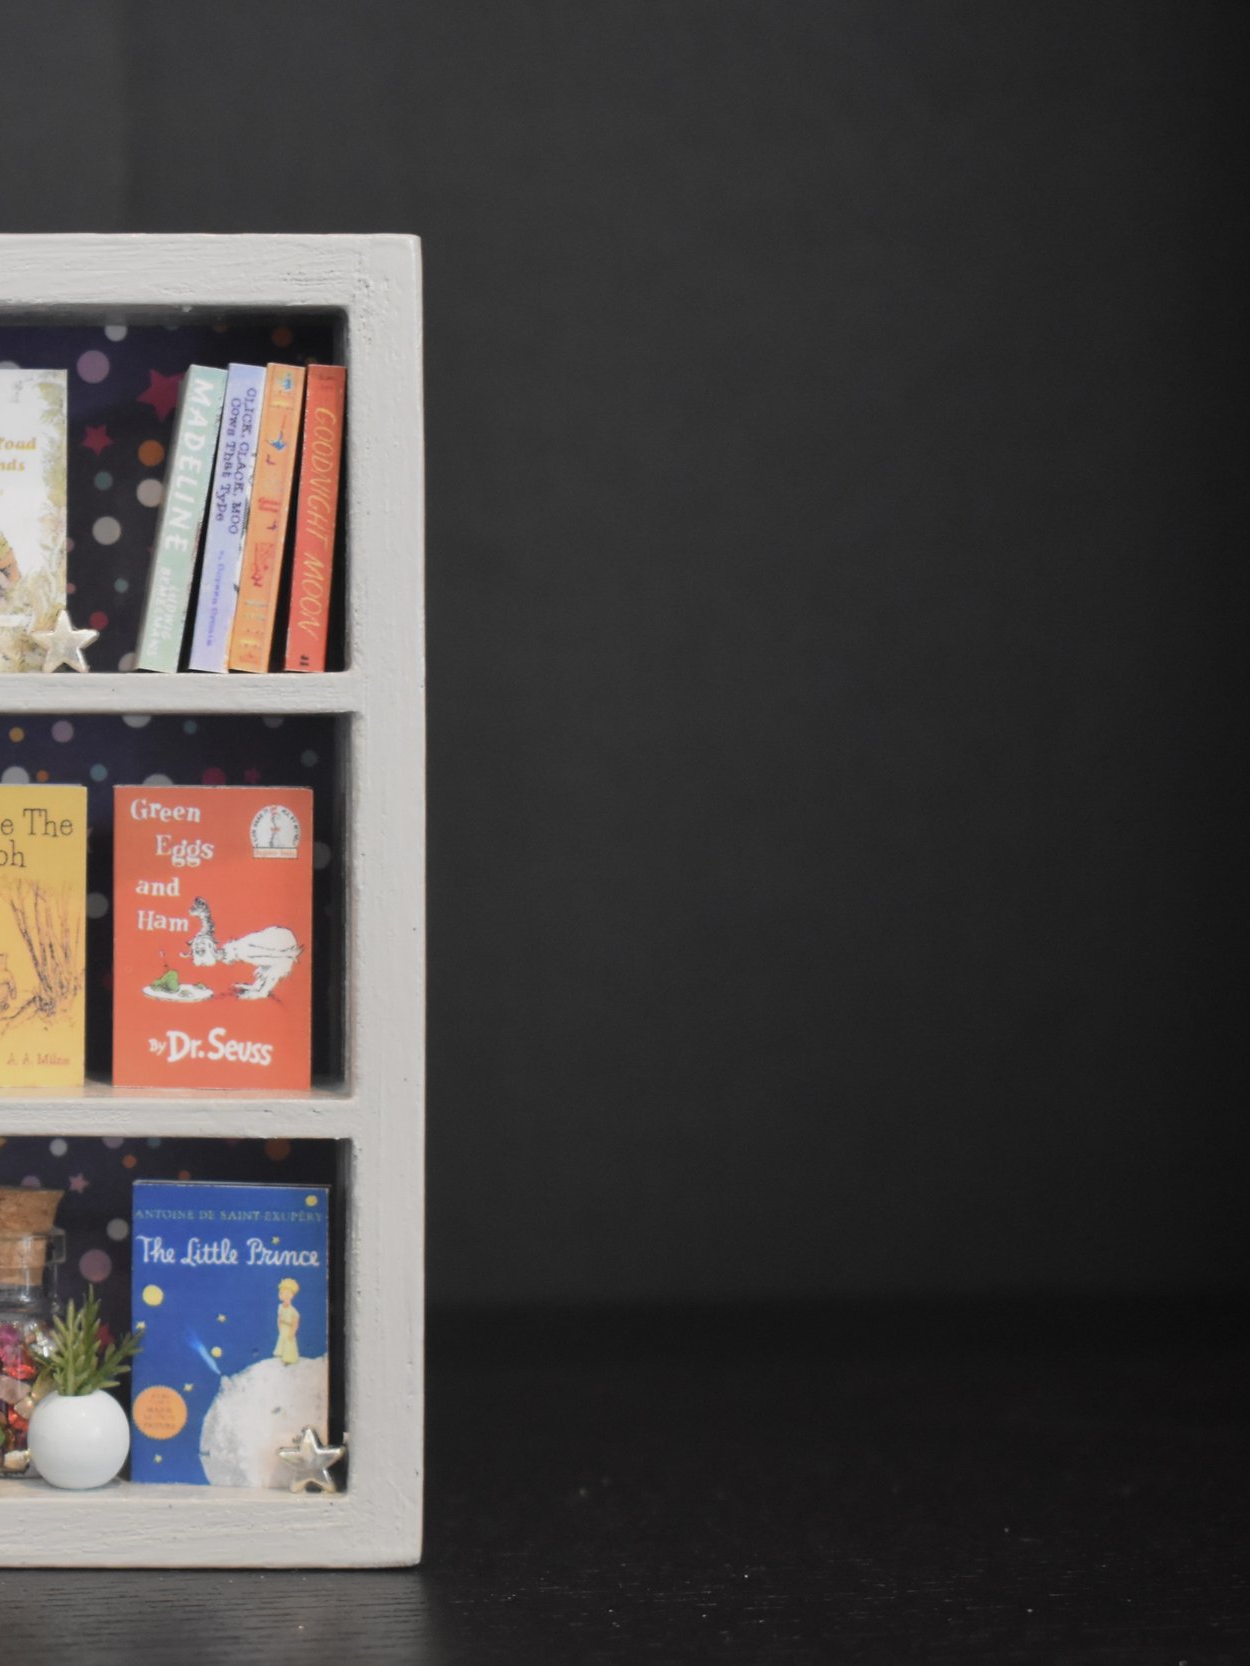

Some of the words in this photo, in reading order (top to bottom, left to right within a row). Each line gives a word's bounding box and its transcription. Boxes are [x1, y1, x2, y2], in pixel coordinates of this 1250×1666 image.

[164, 377, 214, 552] MADELINE
[305, 407, 336, 549] GOODNIGHT
[228, 501, 242, 535] MOO
[297, 552, 325, 641] MOON
[23, 808, 73, 838] The
[130, 798, 201, 823] Green
[155, 834, 215, 868] Eggs
[135, 877, 180, 897] and
[137, 910, 189, 932] Ham
[148, 1038, 166, 1056] By
[166, 1030, 205, 1063] Dr.
[207, 1026, 274, 1066] Seuss
[135, 1209, 194, 1221] ANTOINE
[199, 1210, 214, 1221] DE
[136, 1235, 176, 1264] The
[180, 1237, 239, 1267] Little
[246, 1237, 320, 1267] Prince
